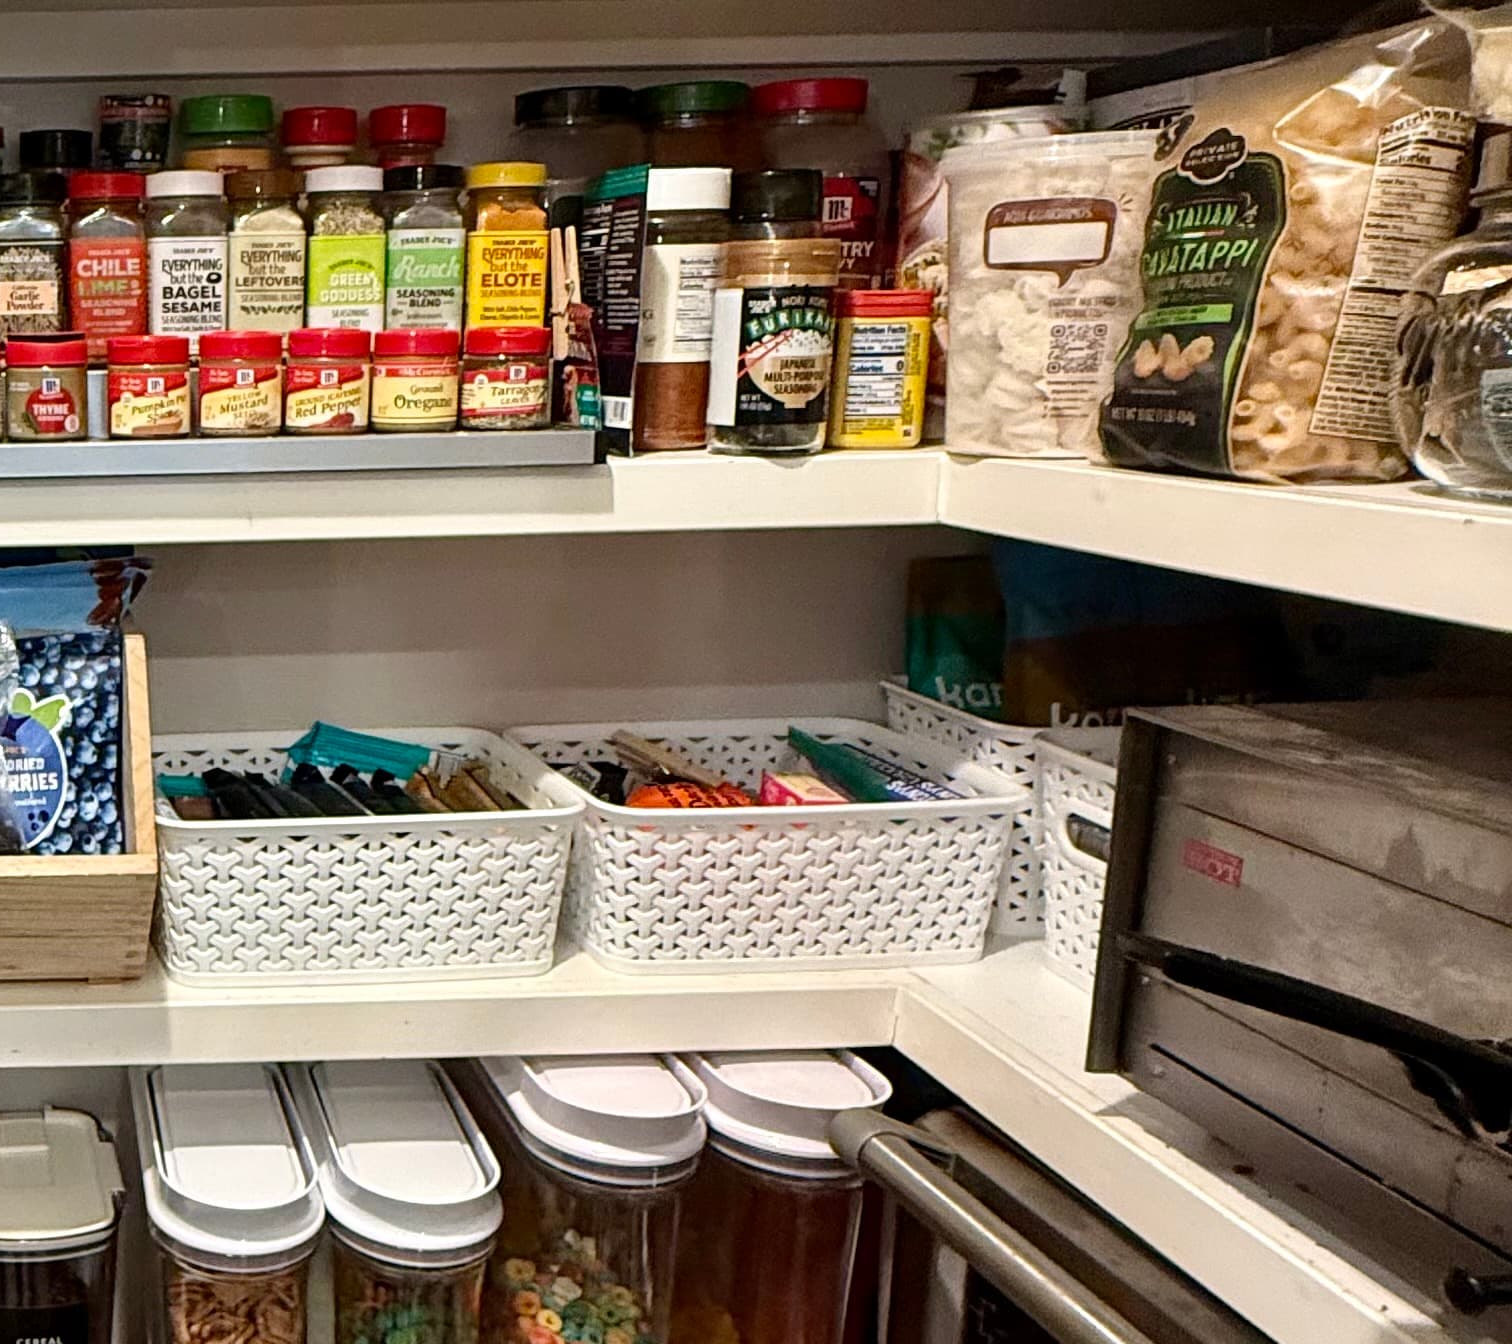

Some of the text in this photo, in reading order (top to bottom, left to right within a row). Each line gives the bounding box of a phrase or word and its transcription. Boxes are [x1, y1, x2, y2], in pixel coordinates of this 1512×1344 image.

[240, 250, 302, 267] EVERYTHING
[482, 246, 544, 263] EVERYTHING
[76, 258, 141, 278] CHILE
[161, 258, 223, 275] EVERYTHING
[248, 262, 286, 275] but the
[394, 254, 460, 284] Ranch
[170, 272, 205, 285] but the
[235, 275, 306, 288] LEFTOVERS
[328, 273, 372, 287] GREEN
[481, 273, 543, 288] ELOTE
[162, 285, 222, 300] BAGEL
[319, 288, 381, 303] GODDESS
[396, 287, 455, 298] SEASONING
[161, 301, 222, 314] SESAME
[408, 297, 442, 307] BLEND
[409, 383, 445, 395] Ground
[31, 403, 70, 416] THYME
[218, 395, 269, 415] Mustard
[294, 394, 362, 419] Red Pepper
[393, 393, 453, 411] Oregano
[6, 757, 46, 771] DRIED
